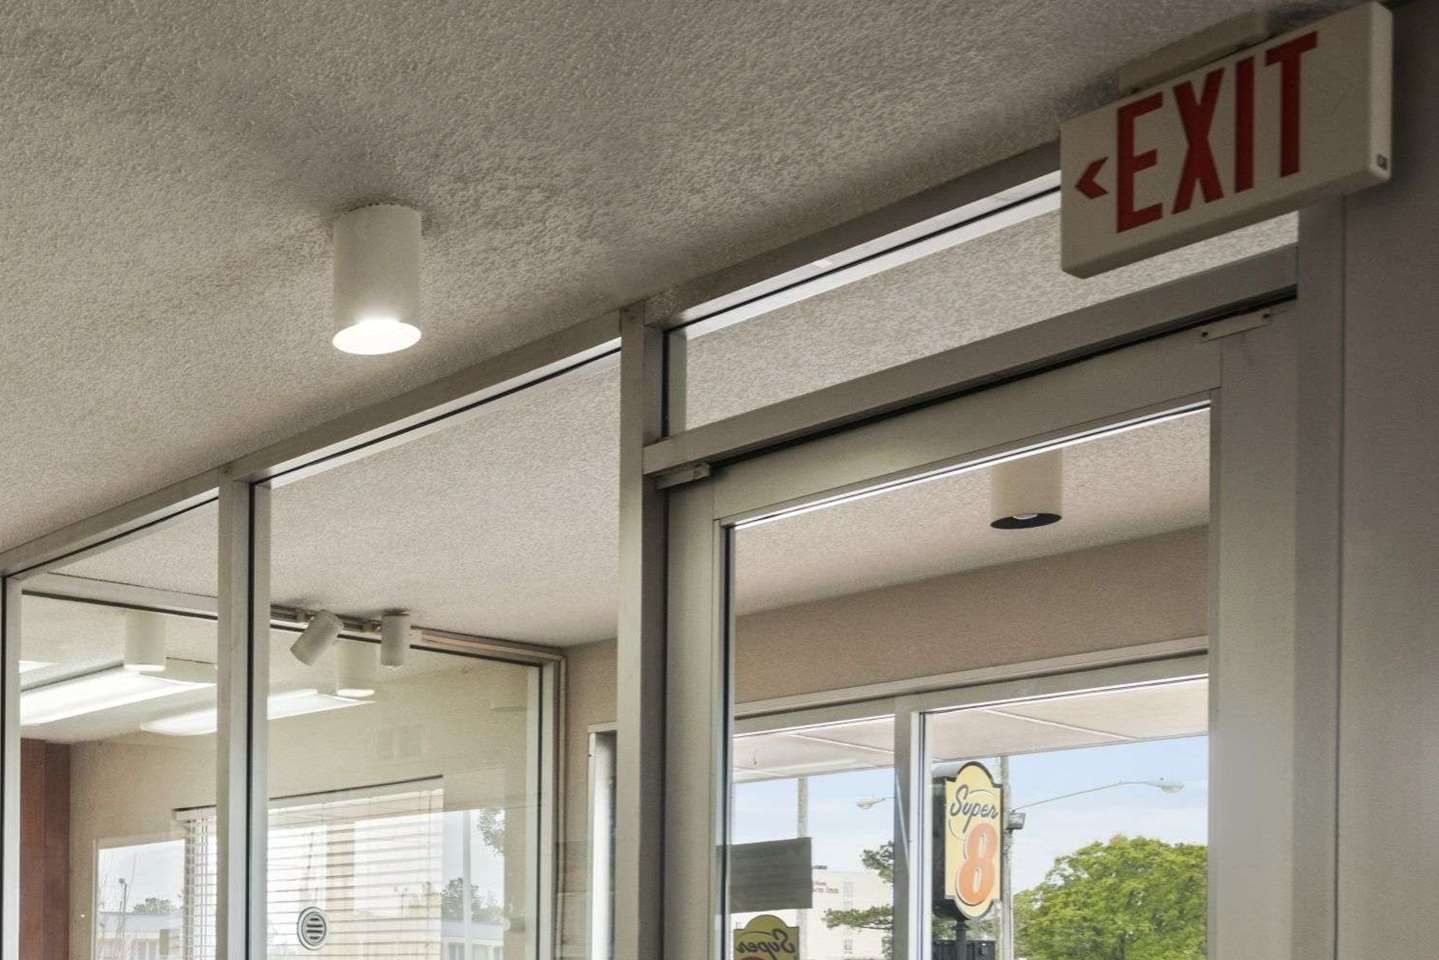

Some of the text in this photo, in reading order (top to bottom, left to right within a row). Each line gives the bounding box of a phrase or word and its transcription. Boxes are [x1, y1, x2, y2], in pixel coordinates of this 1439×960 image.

[1116, 30, 1318, 233] EXIT
[950, 784, 999, 833] Super
[955, 822, 998, 907] 8
